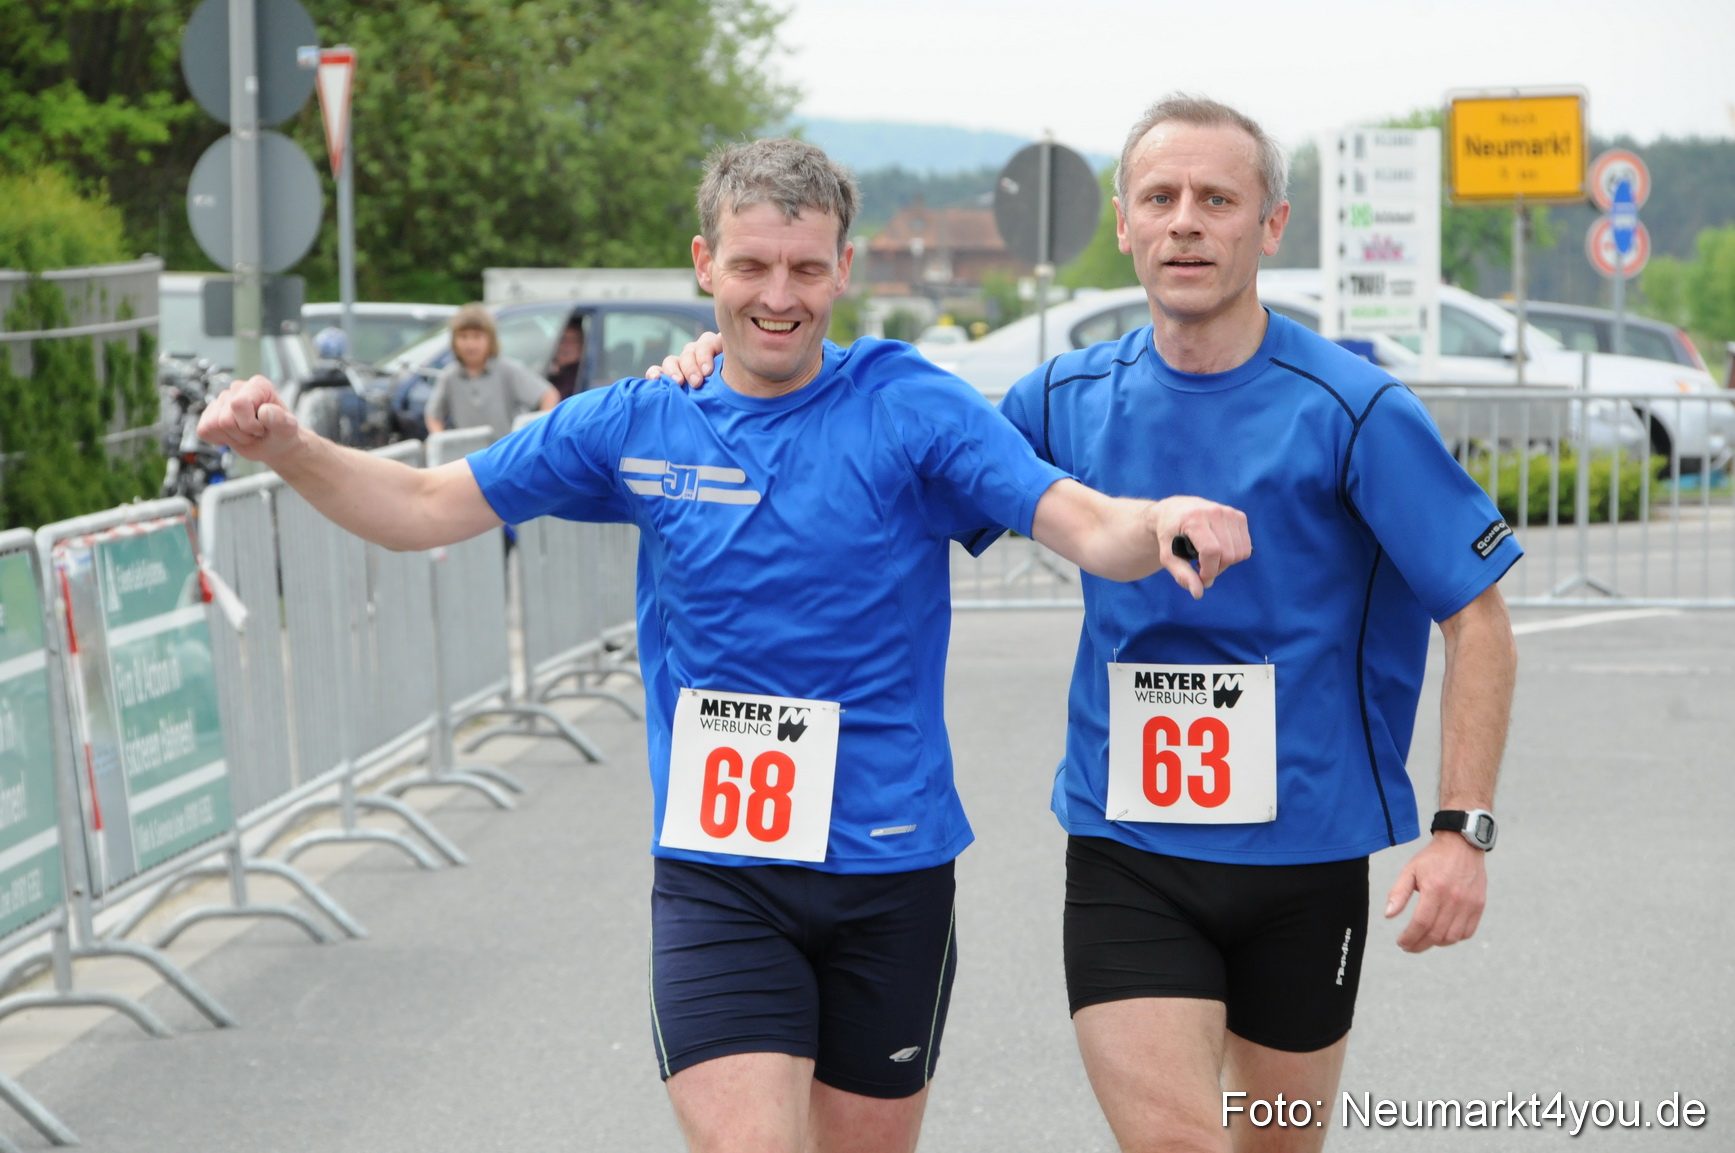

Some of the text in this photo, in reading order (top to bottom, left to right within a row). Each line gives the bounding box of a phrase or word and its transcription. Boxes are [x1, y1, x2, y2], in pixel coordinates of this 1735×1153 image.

[1464, 132, 1572, 157] Neumarkt
[1134, 671, 1207, 690] MEYER
[1134, 690, 1208, 705] WERBUNG
[700, 698, 773, 722] MEYER
[700, 717, 772, 736] WERBUNG
[1142, 715, 1231, 808] 63
[700, 746, 796, 843] 68
